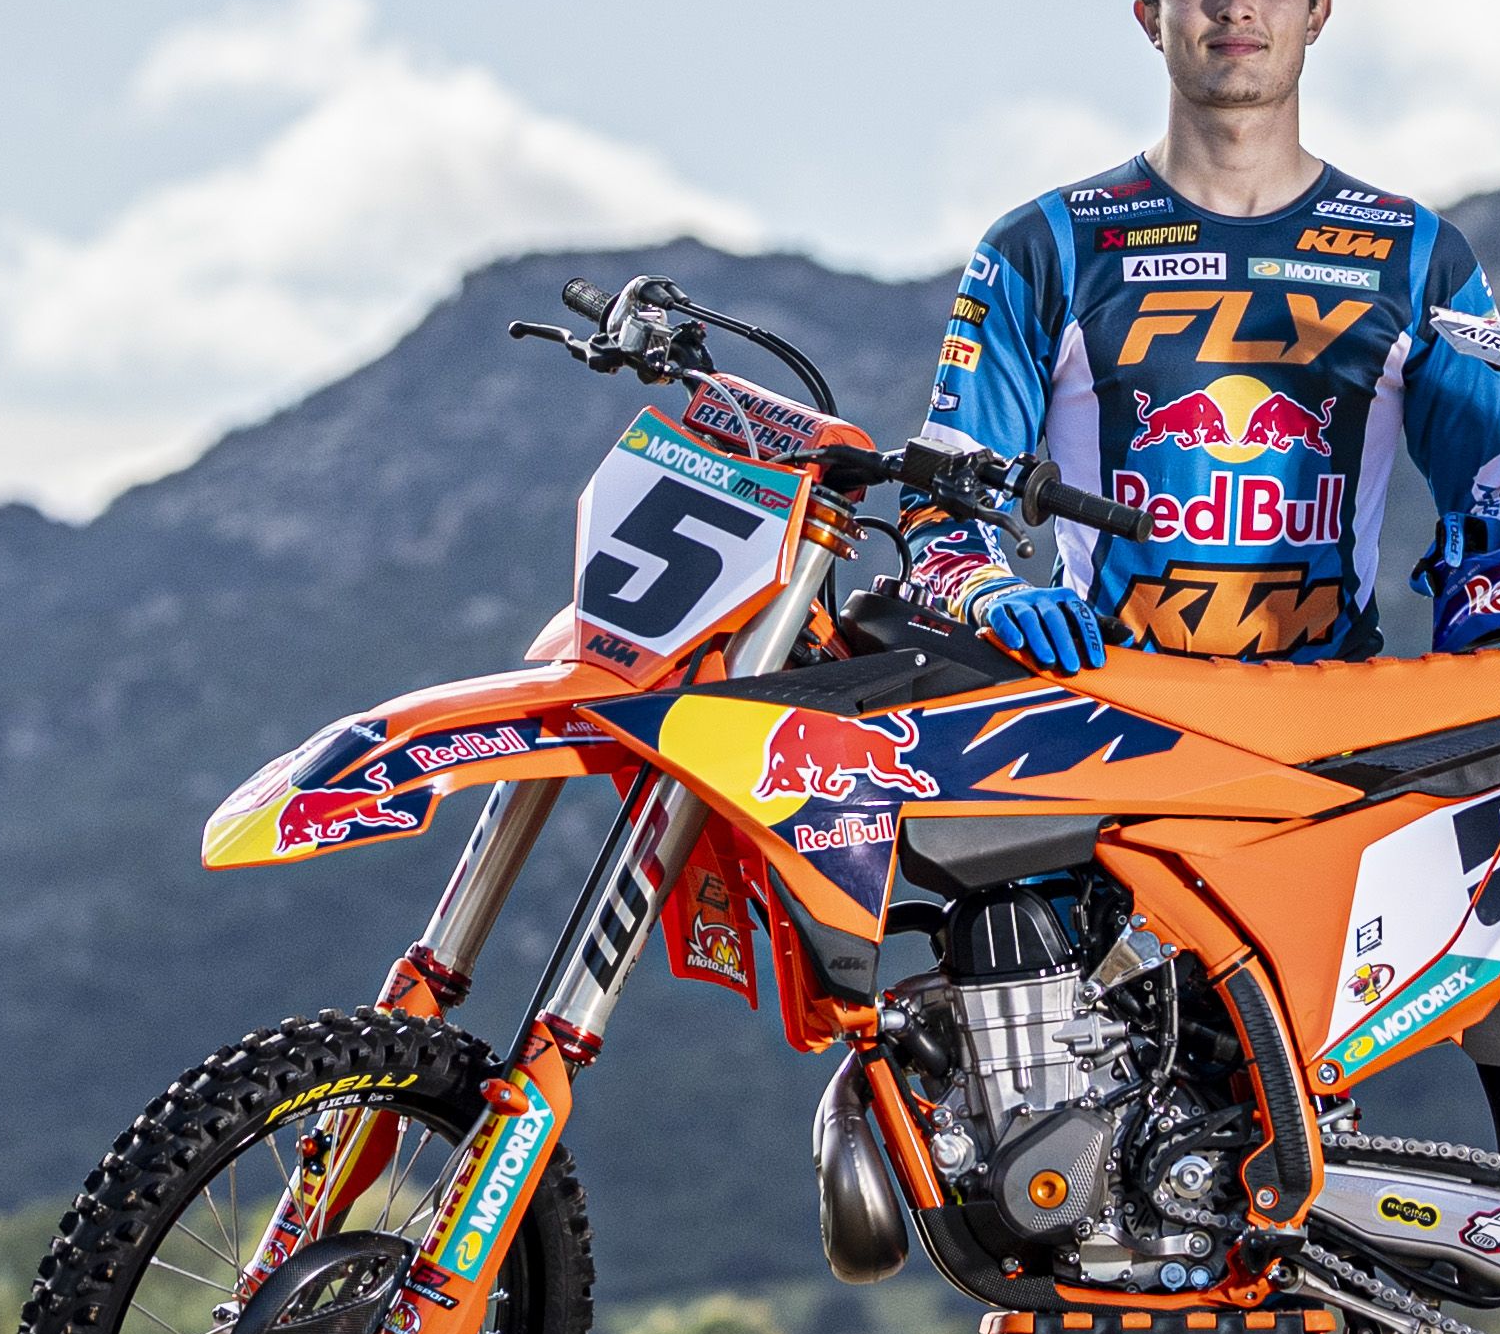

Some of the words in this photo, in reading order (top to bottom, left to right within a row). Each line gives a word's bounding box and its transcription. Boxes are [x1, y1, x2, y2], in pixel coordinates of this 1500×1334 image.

[1072, 207, 1100, 217] VAN
[1103, 204, 1129, 215] DEN
[1132, 198, 1165, 211] BOER
[1127, 224, 1198, 246] AKRAPOVIC
[1297, 226, 1393, 260] KTM
[1131, 257, 1220, 278] AIROH
[1285, 262, 1370, 287] MOTOREX
[1117, 291, 1373, 365] FLY
[704, 383, 816, 437] RENTHAL
[645, 432, 736, 490] MOTOREX
[732, 477, 793, 509] MXGP
[1113, 470, 1233, 547] Red
[1235, 473, 1346, 547] Bull
[579, 476, 765, 638] 5
[1117, 565, 1342, 658] KTM
[586, 635, 639, 669] KTM
[407, 734, 473, 772] Red
[466, 726, 530, 761] Bull
[796, 821, 847, 853] Red
[847, 813, 895, 846] Bull
[1371, 967, 1477, 1047] MOTOREX
[264, 1074, 418, 1125] PIRELLI
[317, 1094, 361, 1111] EXCEL
[469, 1099, 551, 1234] MOTOREX
[1387, 1200, 1431, 1220] REGINA
